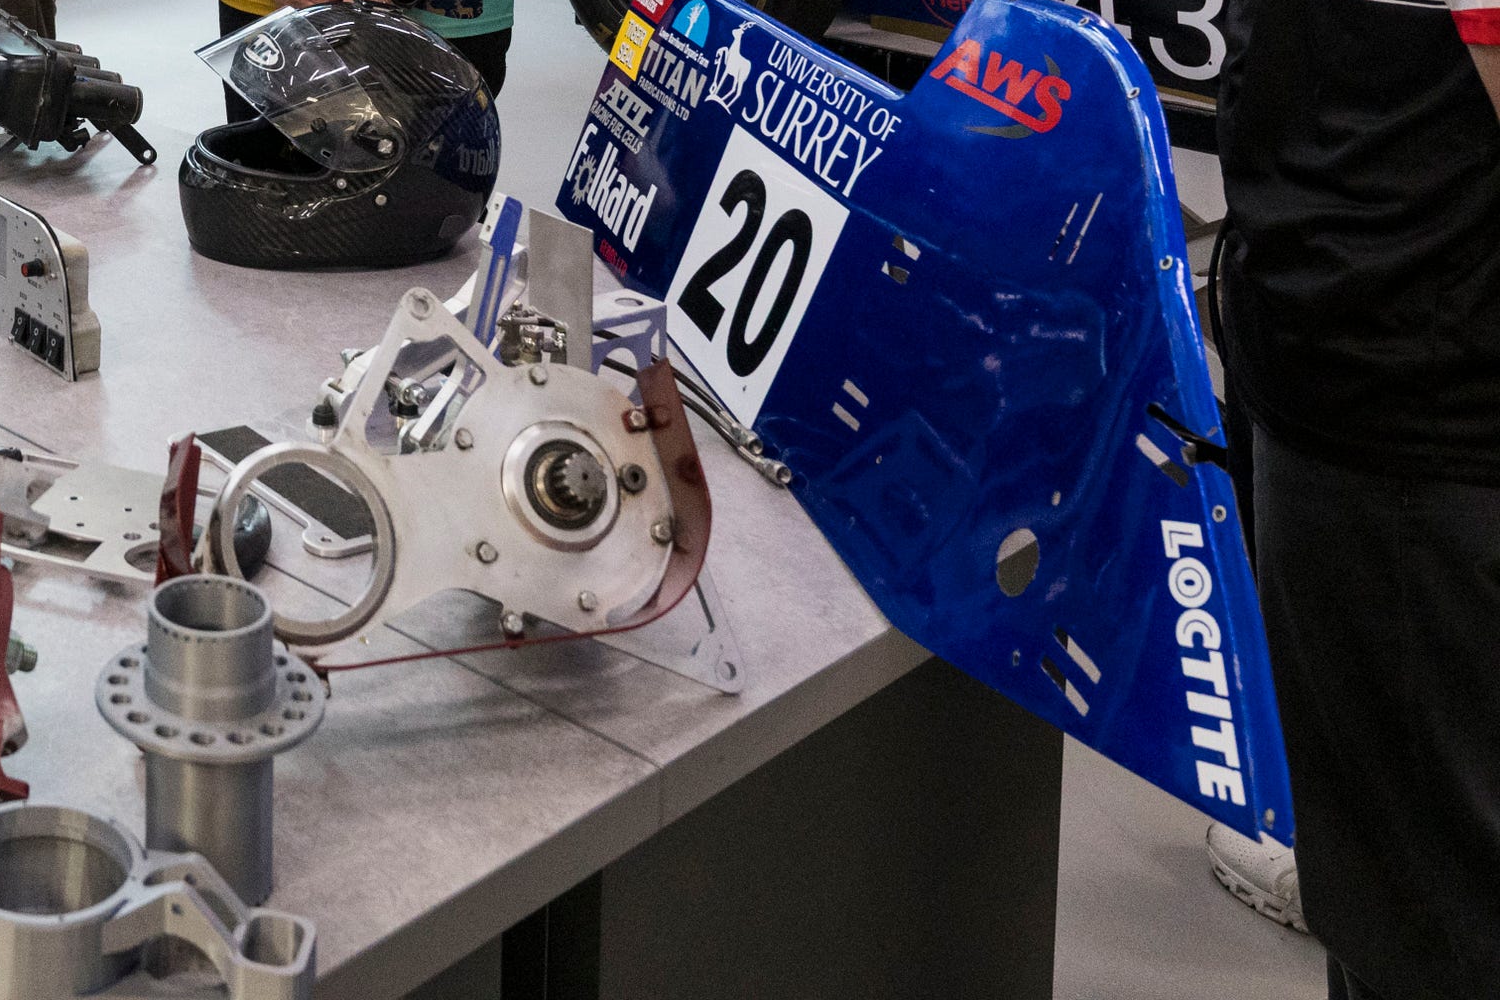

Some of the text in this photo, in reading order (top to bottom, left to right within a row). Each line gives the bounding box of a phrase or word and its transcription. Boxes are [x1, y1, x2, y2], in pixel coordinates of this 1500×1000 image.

[637, 75, 690, 122] FABRICATIONS LTD
[642, 38, 707, 109] TITAN
[767, 40, 902, 143] UNIVERSITY OF
[930, 39, 1072, 134] AWS
[606, 114, 624, 140] FUEL
[620, 128, 644, 155] CELLS
[741, 70, 883, 199] SURREY
[565, 122, 658, 253] Folkard
[676, 168, 813, 378] 20
[1160, 519, 1246, 806] LOCTITE
